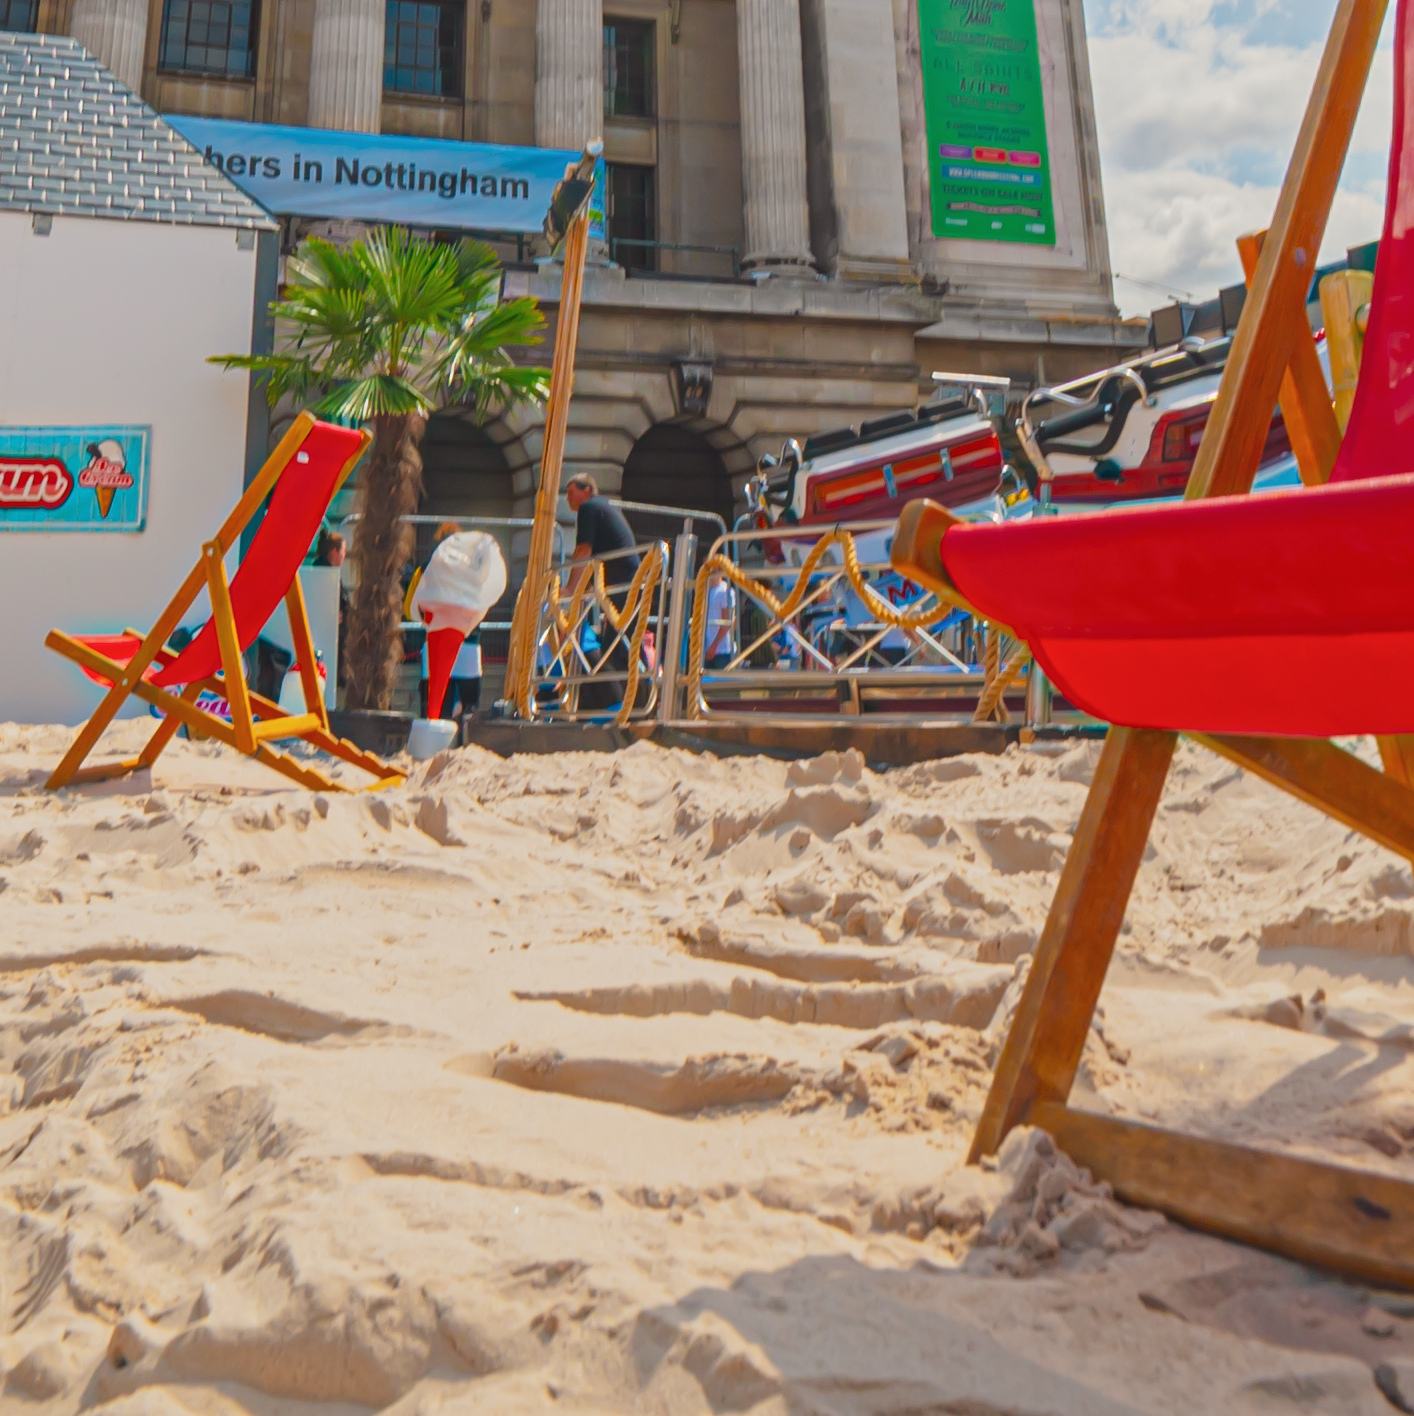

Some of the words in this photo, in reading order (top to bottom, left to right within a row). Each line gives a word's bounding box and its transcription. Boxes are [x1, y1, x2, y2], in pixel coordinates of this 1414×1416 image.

[293, 152, 323, 183] in
[335, 156, 530, 200] Nottingham
[79, 469, 134, 488] Cream
